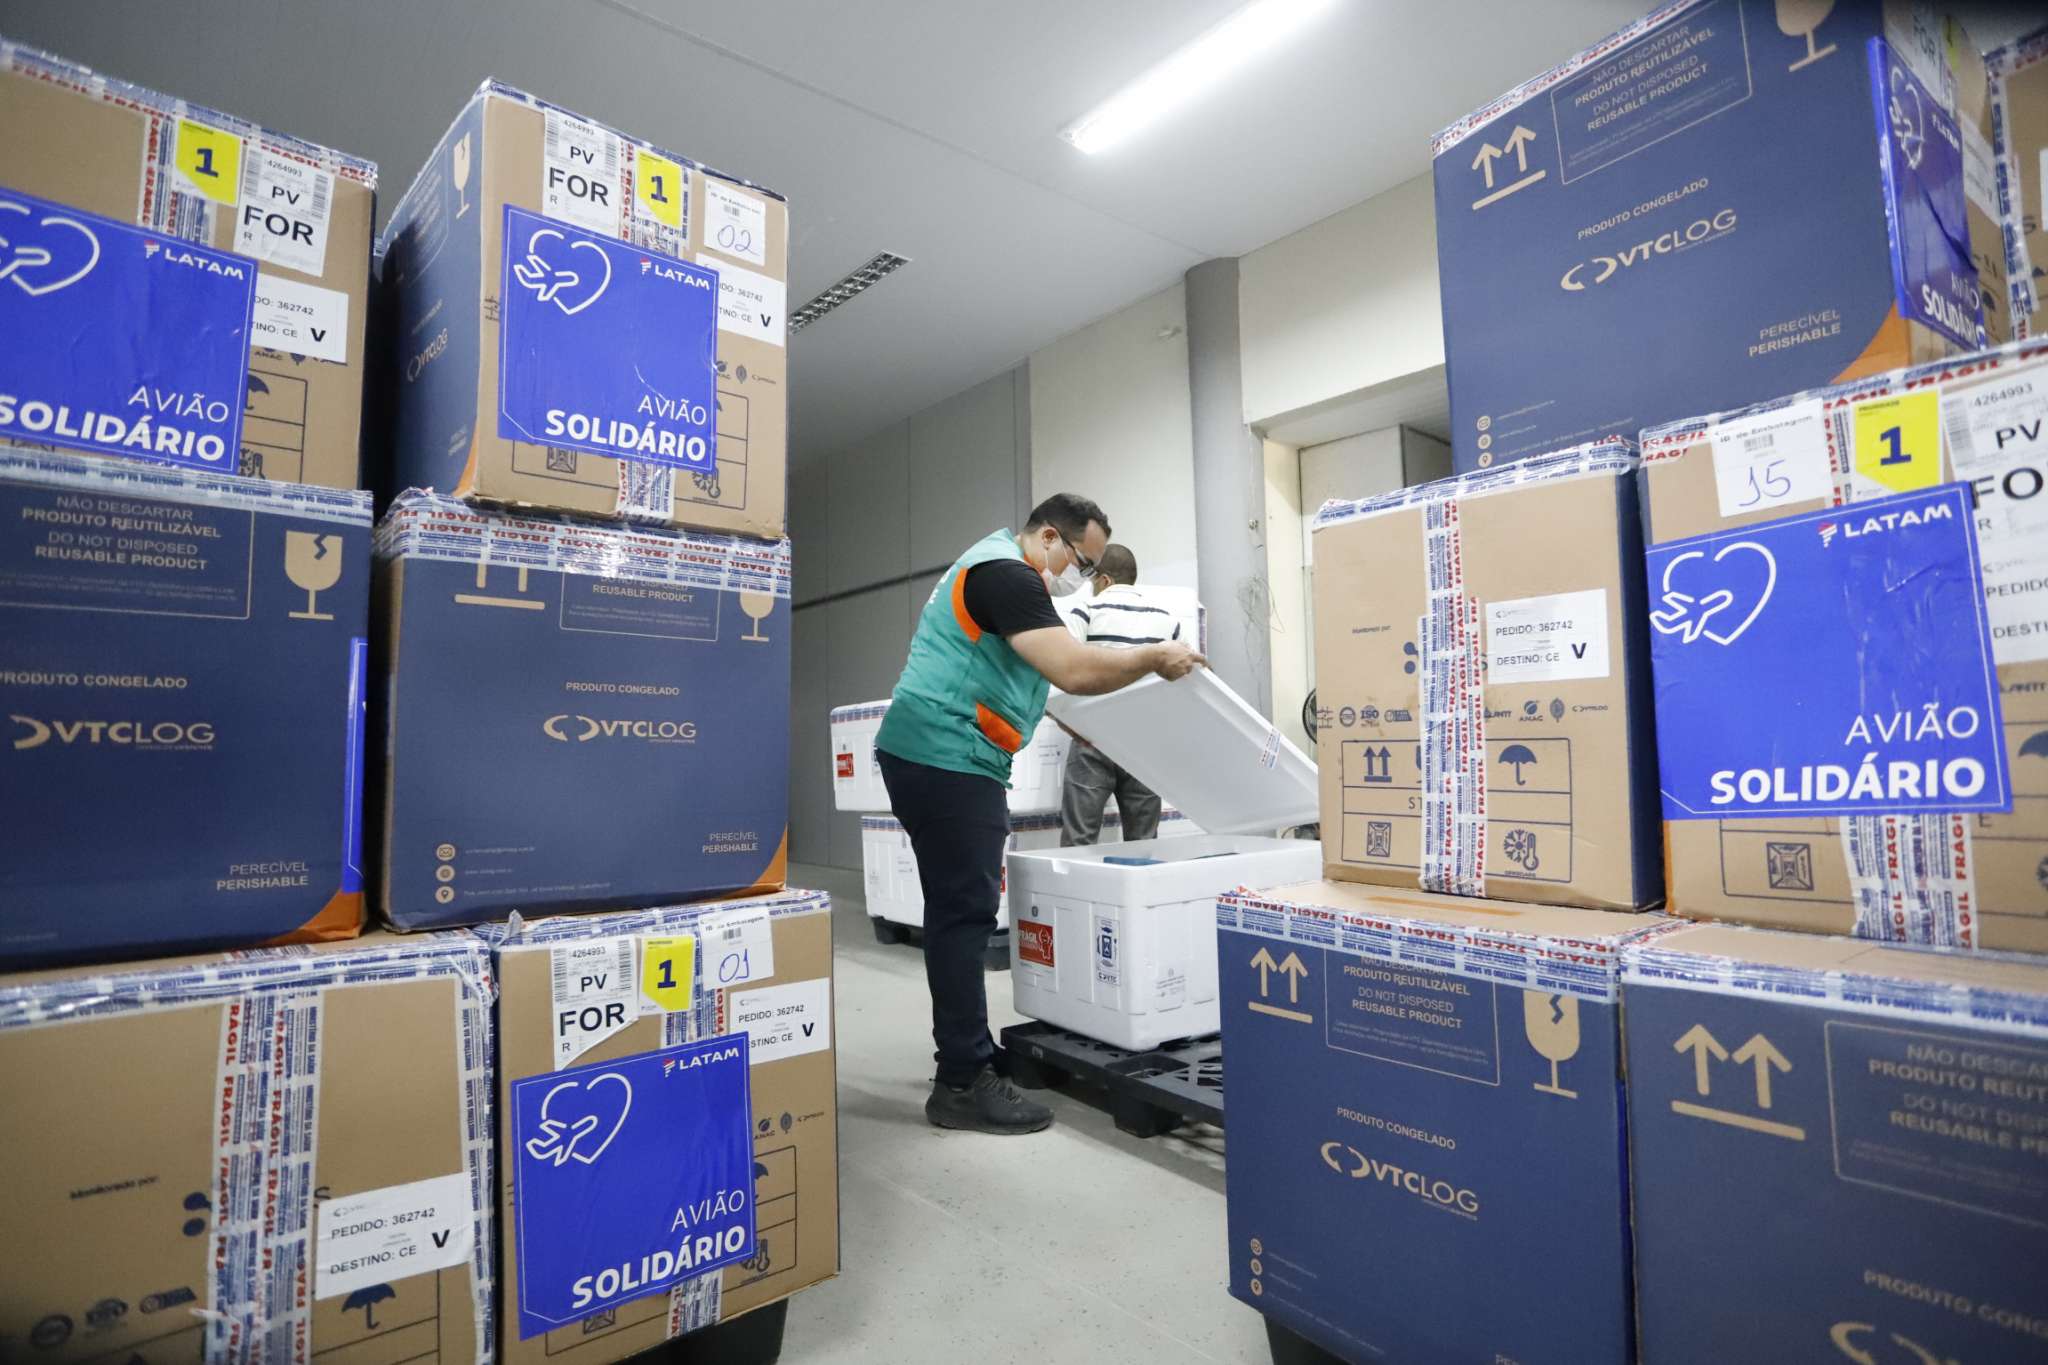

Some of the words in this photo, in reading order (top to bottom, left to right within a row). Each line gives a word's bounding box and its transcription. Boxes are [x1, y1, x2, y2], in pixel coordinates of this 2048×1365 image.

[1575, 74, 1629, 108] PRODUTO
[1630, 27, 1713, 78] REUTILIZÁVEL
[1592, 64, 1617, 85] NÃO
[1619, 26, 1690, 71] DESCARTAR
[1587, 94, 1649, 133] REUSABLE
[1649, 63, 1709, 100] PRODUCT
[1593, 101, 1610, 116] DO
[1611, 88, 1635, 109] NOT
[1637, 55, 1699, 92] DISPOSED
[194, 148, 220, 178] 1
[267, 160, 303, 177] 4264993
[570, 145, 594, 165] PV
[271, 186, 300, 205] PV
[549, 166, 609, 207] FOR
[549, 194, 558, 205] R
[650, 175, 668, 203] 1
[1577, 211, 1630, 240] PRODUTO
[1633, 177, 1708, 217] CONGELADO
[243, 204, 315, 247] FOR
[243, 231, 253, 241] R
[1617, 208, 1737, 267] VTCLOG
[717, 224, 760, 256] 02
[164, 248, 244, 281] LATAM
[654, 263, 711, 291] LATAM
[278, 300, 314, 316] 362742
[737, 287, 763, 303] 362742
[282, 328, 298, 338] CE
[310, 327, 327, 342] V
[760, 313, 772, 328] V
[1759, 309, 1841, 340] PERECÍVEL
[1749, 322, 1841, 357] PERISHABLE
[1903, 358, 1999, 389] FRÁGIL
[128, 384, 230, 424] AVIÃO
[1974, 382, 2033, 407] 4264993
[637, 394, 707, 426] AVIÃO
[0, 394, 226, 461] SOLIDÁRIO
[545, 409, 706, 462] SOLIDÁRIO
[1995, 419, 2041, 449] PV
[1880, 426, 1912, 466] 1
[1971, 467, 2048, 510] FO
[56, 495, 94, 511] NÃO
[97, 500, 194, 521] DESCARTAR
[1843, 502, 1952, 538] LATAM
[22, 507, 107, 528] PRODUTO
[111, 513, 222, 539] REUTILIZÁVEL
[1978, 518, 1992, 530] R
[48, 530, 74, 545] DO
[78, 533, 113, 549] NOT
[117, 536, 198, 556] DISPOSED
[35, 545, 126, 565] REUSABLE
[131, 553, 208, 571] PRODUCT
[592, 585, 646, 598] REUSABLE
[648, 589, 694, 603] PRODUCT
[1495, 624, 1536, 637] PEDIDO:
[1538, 620, 1573, 632] 362742
[1496, 653, 1543, 666] DESTINO:
[1545, 652, 1560, 662] CE
[1571, 642, 1587, 659] V
[83, 675, 188, 689] CONGELADO
[565, 682, 616, 693] PRODUTO
[618, 684, 680, 696] CONGELADO
[1360, 709, 1379, 719] ISO
[1845, 702, 1979, 747] AVIÃO
[52, 721, 215, 744] VTCLOG
[599, 720, 697, 738] VTCLOG
[1710, 752, 1986, 804] SOLIDÁRIO
[702, 842, 759, 854] PERISHABLE
[709, 831, 758, 842] PERECÍVEL
[229, 861, 309, 876] PERECÍVEL
[216, 875, 309, 891] PERISHABLE
[572, 946, 606, 958] 4264993
[580, 973, 608, 992] PV
[657, 959, 677, 989] 1
[1343, 965, 1392, 983] PRODUTO
[1393, 973, 1471, 996] REUTILIZÁVEL
[738, 1010, 775, 1023] PEDIDO:
[776, 1004, 805, 1016] 362742
[1358, 986, 1373, 998] DO
[1375, 989, 1396, 1003] NOT
[1398, 994, 1454, 1013] DISPOSED
[559, 1002, 625, 1037] FOR
[1352, 999, 1406, 1019] REUSABLE
[1408, 1010, 1462, 1029] PRODUCT
[749, 1036, 779, 1048] STINO:
[781, 1032, 793, 1042] CE
[802, 1022, 815, 1037] V
[562, 1042, 571, 1052] R
[679, 1046, 740, 1071] LATAM
[1906, 1043, 1954, 1065] NÃO
[1868, 1058, 1976, 1091] PRODUTO
[1903, 1093, 1936, 1112] DO
[1337, 1106, 1384, 1129] PRODUTO
[1386, 1121, 1456, 1150] CONGELADO
[1889, 1110, 2013, 1148] REUSABLE
[1370, 1159, 1479, 1214] VTCLOG
[331, 1219, 388, 1239] PEDIDO:
[392, 1207, 436, 1225] 362742
[671, 1189, 745, 1233] AVIÃO
[431, 1229, 450, 1249] V
[330, 1250, 395, 1274] DESTINO:
[398, 1245, 417, 1257] CE
[572, 1225, 746, 1309] SOLIDÁRIO
[1864, 1269, 1972, 1314] PRODUTO
